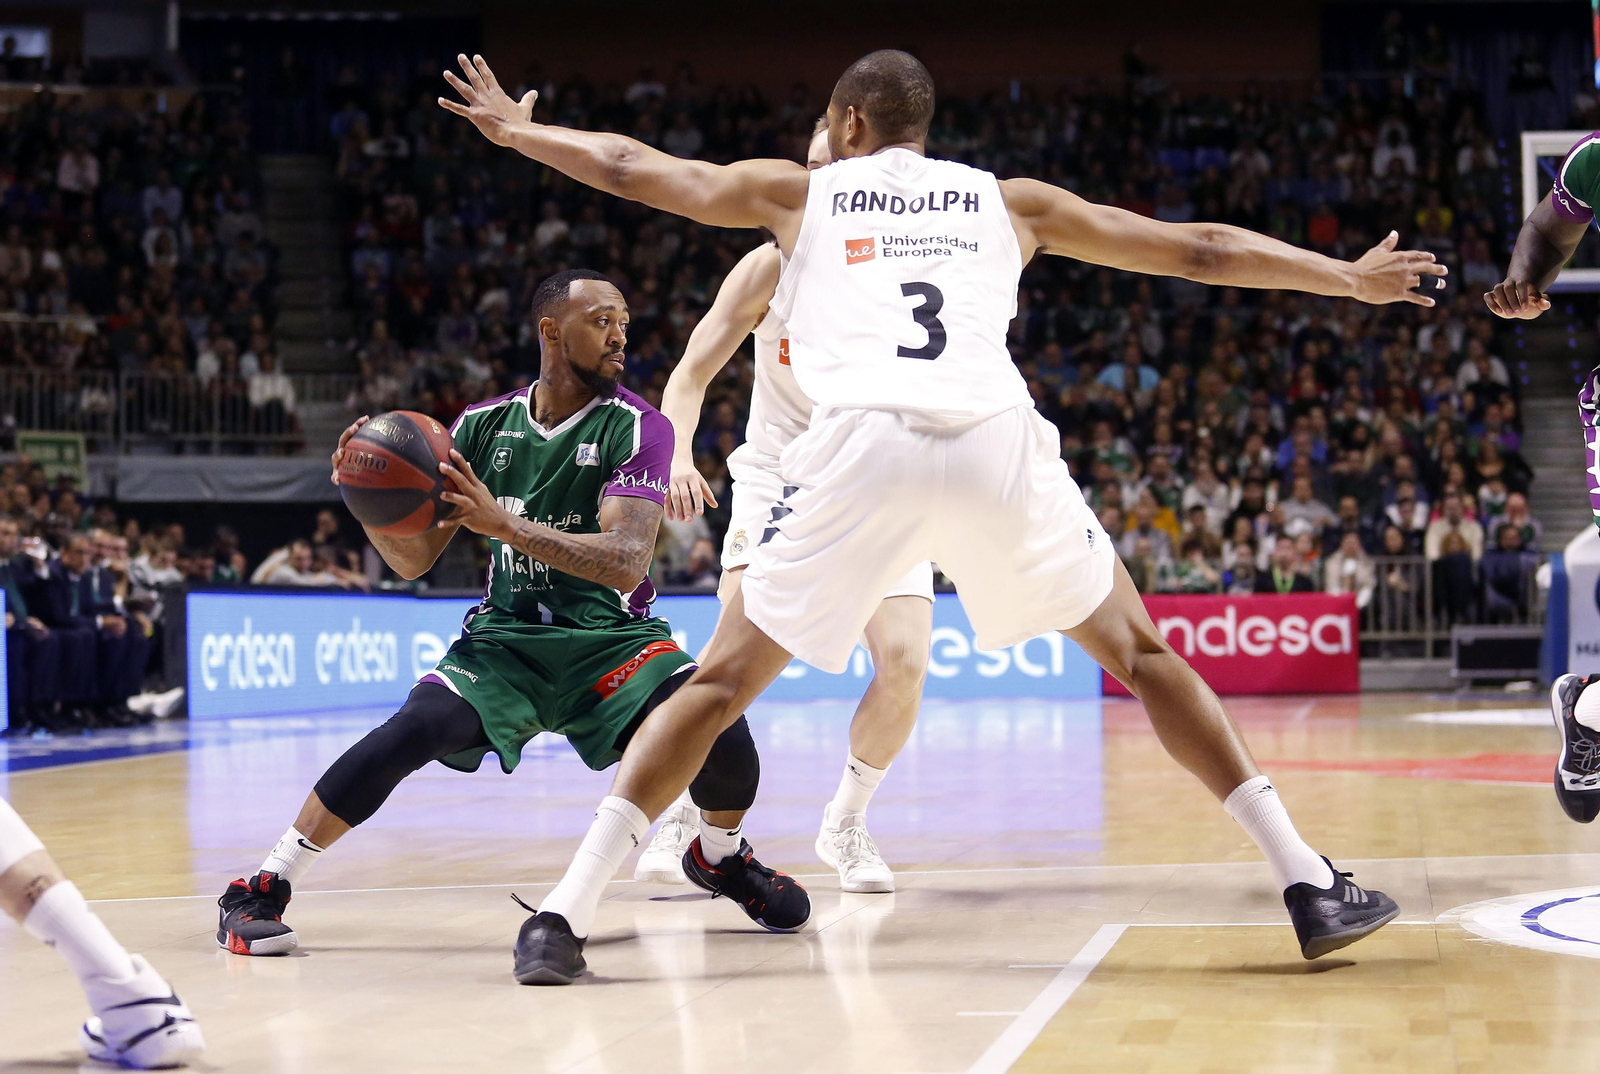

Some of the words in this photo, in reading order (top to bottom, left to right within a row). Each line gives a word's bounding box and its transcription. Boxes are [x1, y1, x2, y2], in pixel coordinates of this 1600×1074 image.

[832, 190, 979, 216] RANDOLPH
[882, 235, 978, 252] Universidad
[883, 247, 953, 258] Europea
[897, 282, 947, 361] 3
[493, 430, 525, 439] SPALDING
[1157, 605, 1352, 657] ndesa
[201, 617, 296, 691] endesa
[315, 617, 398, 685] endesa
[443, 664, 478, 683] SPALDING
